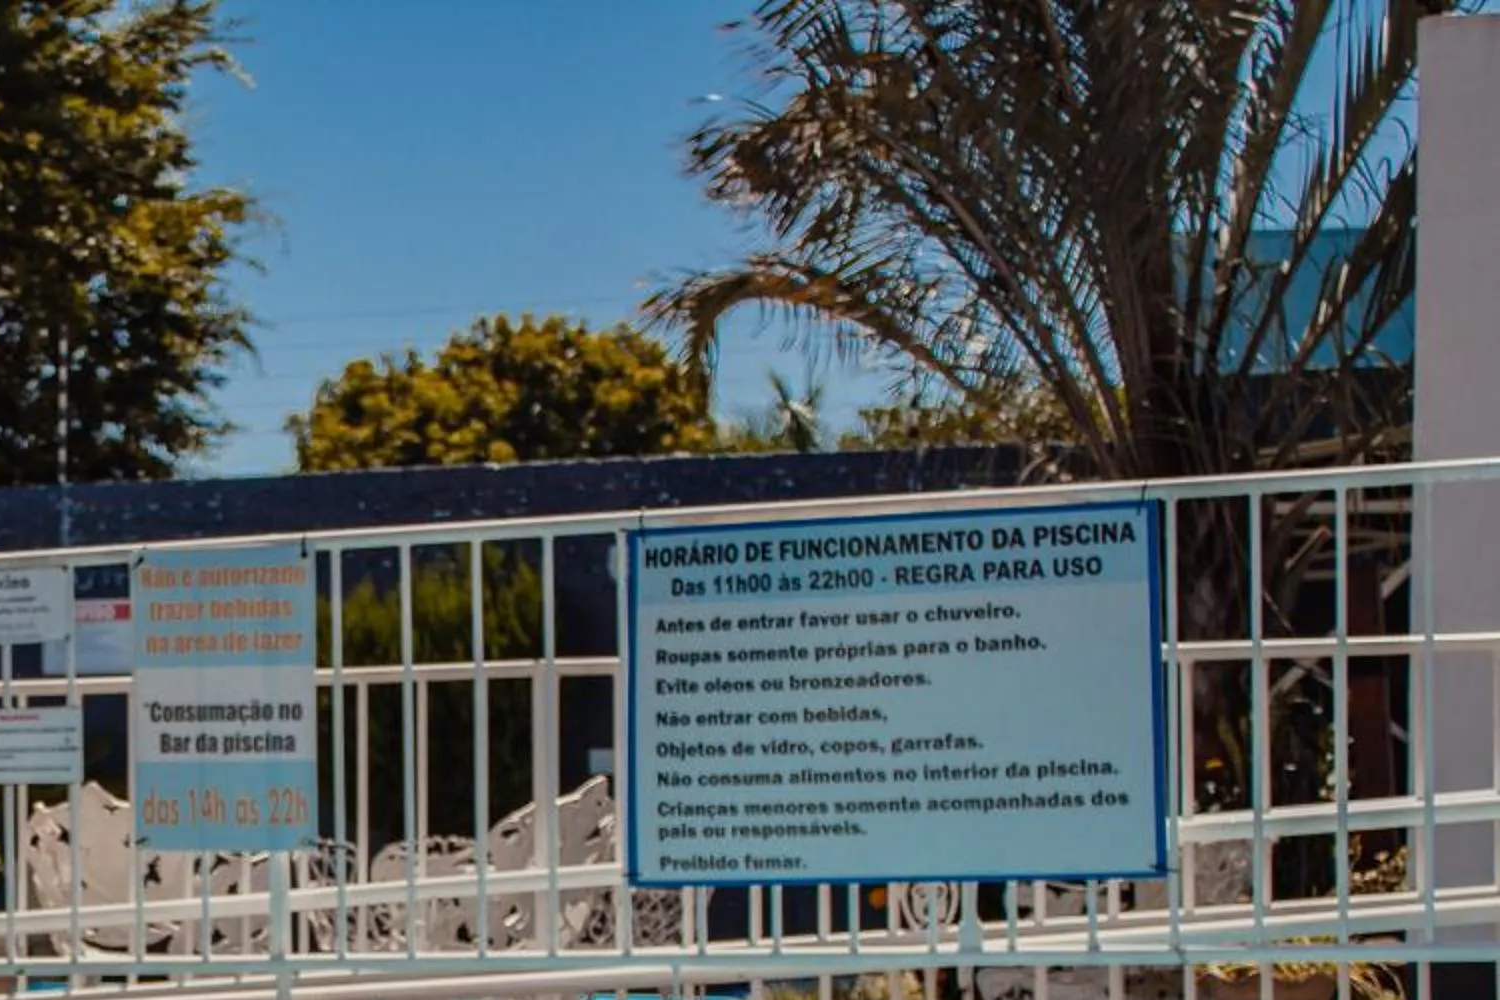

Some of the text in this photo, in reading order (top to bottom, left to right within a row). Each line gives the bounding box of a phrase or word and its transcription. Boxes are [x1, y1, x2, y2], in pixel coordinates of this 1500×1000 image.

[645, 521, 1136, 568] HORÁRIO DE FUNCIONAMENTO DA PISCINA
[671, 577, 706, 596] Das
[713, 574, 772, 594] 11h00
[808, 569, 874, 590] 22h00
[895, 564, 976, 585] REGRA
[982, 559, 1045, 580] PARA
[1053, 556, 1104, 577] USO
[655, 602, 1021, 634] Antes de entrar favor usar o chuveiro.
[655, 634, 1047, 666] Roupas somente próprias para o banho.
[655, 678, 699, 696] Evite
[760, 679, 784, 691] ou
[789, 672, 932, 691] bronzeadores.
[278, 703, 303, 721] no
[655, 711, 691, 727] Não
[695, 709, 752, 726] entrar
[757, 710, 798, 725] com
[160, 732, 297, 754] Bar da piscina
[655, 741, 727, 761] Objetos
[732, 742, 755, 757] de
[761, 738, 815, 756] vidro,
[890, 732, 984, 756] garrafas.
[656, 759, 1120, 788] Não consuma alimentos no interior da piscina.
[268, 788, 310, 824] 22h
[657, 790, 1131, 821] Crianças menores somente acompanhadas dos
[702, 825, 727, 838] ou
[659, 855, 740, 872] Proibido
